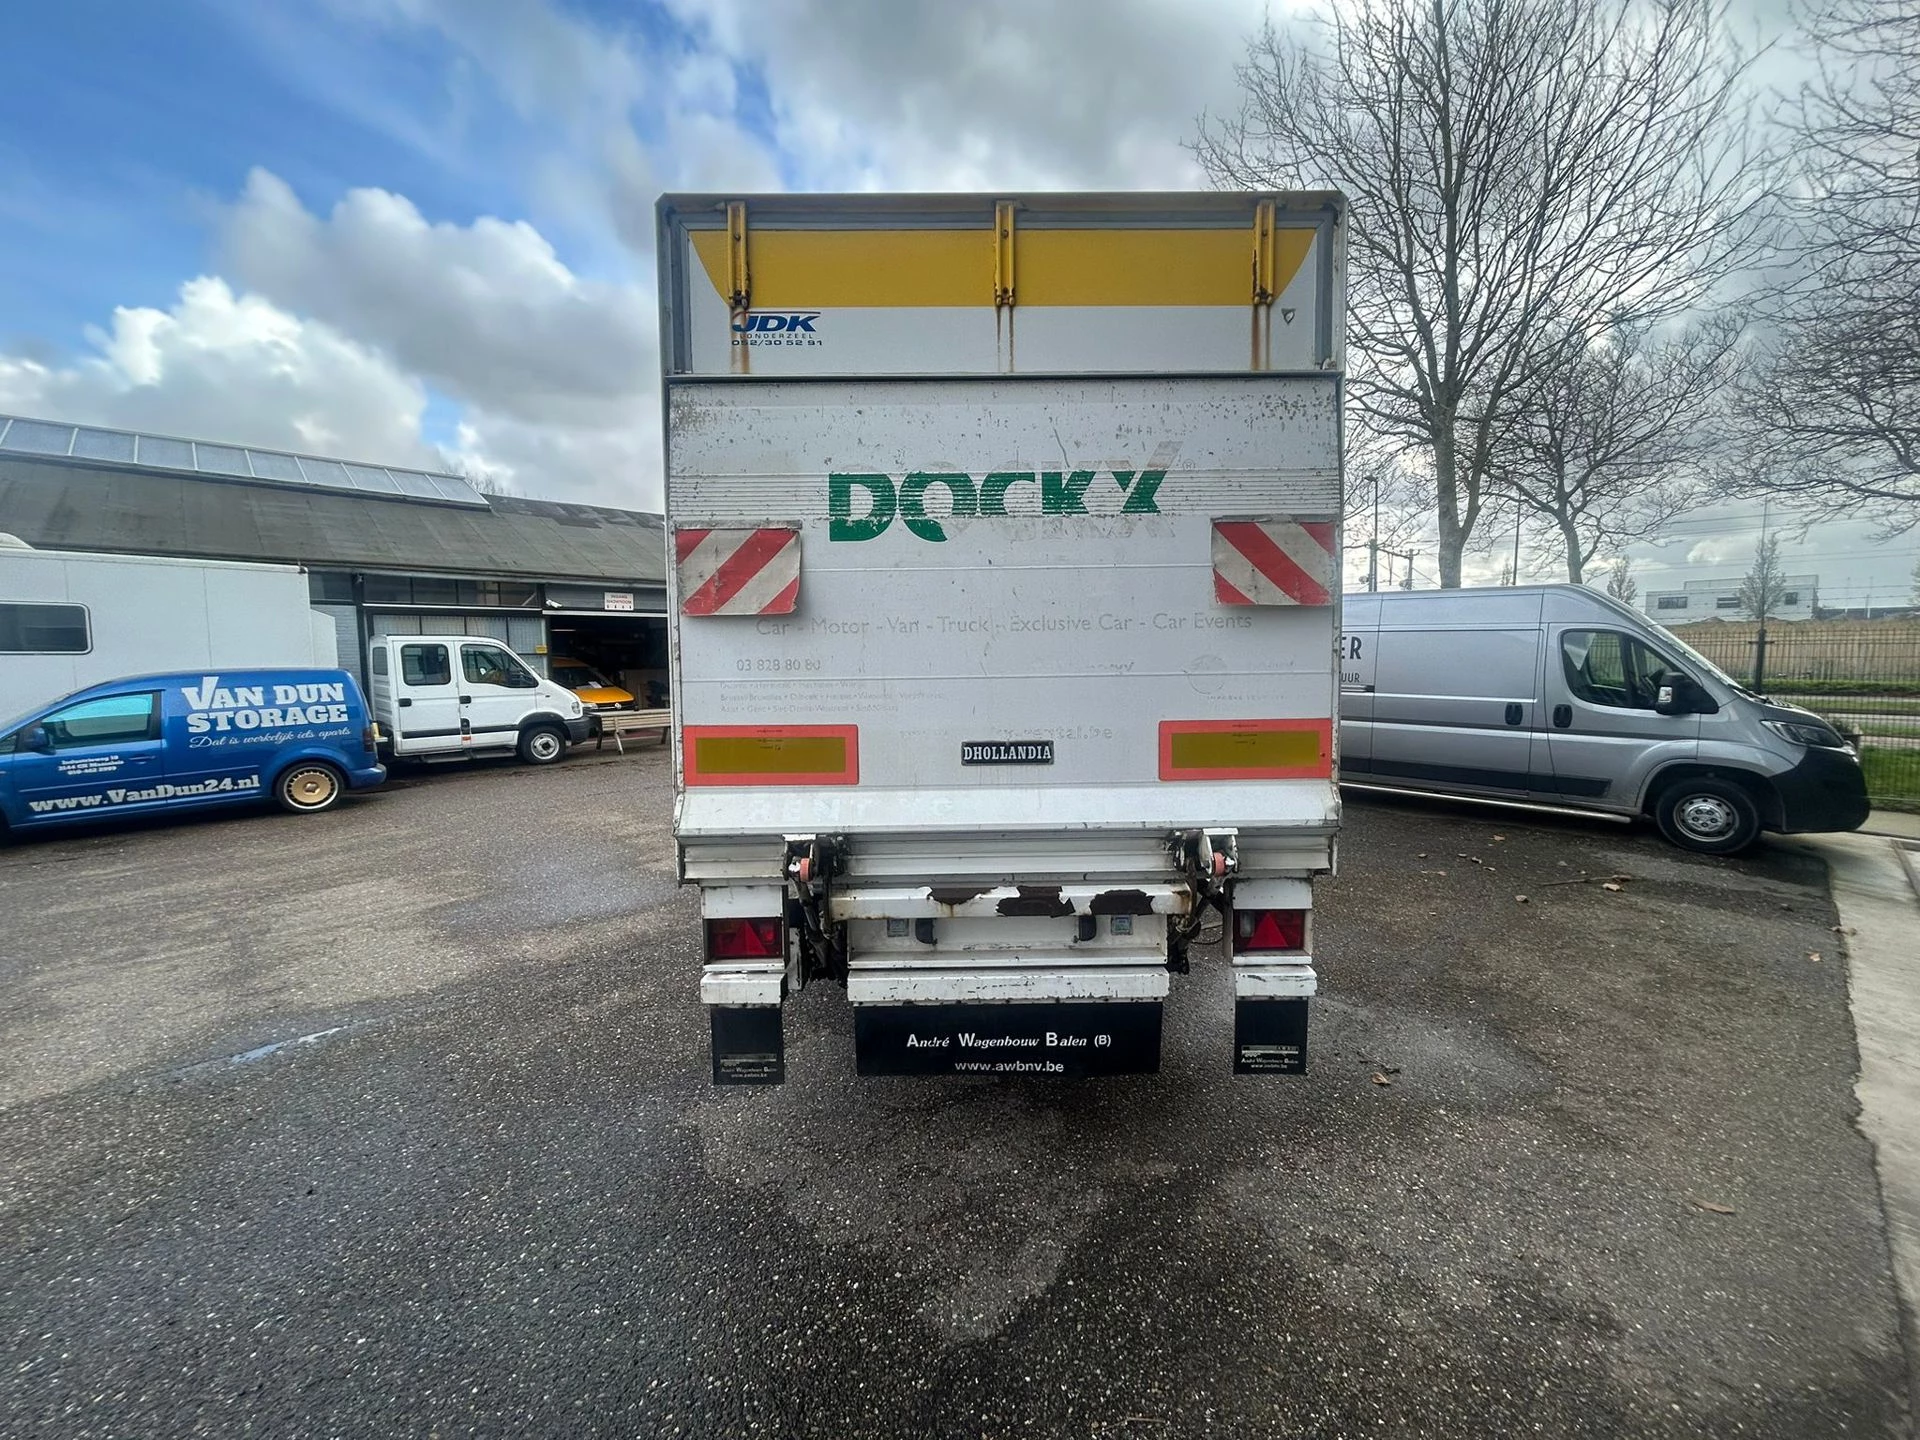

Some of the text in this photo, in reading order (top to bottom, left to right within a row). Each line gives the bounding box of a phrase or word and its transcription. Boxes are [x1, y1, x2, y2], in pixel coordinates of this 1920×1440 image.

[732, 315, 820, 332] JDK
[756, 619, 790, 636] Car
[812, 618, 869, 635] Motor
[887, 617, 919, 634] Van
[937, 616, 988, 633] Truck
[1010, 614, 1091, 632] Exclusive
[1099, 614, 1131, 631] Car
[1153, 613, 1186, 630] Car
[1194, 613, 1252, 630] Events
[736, 659, 751, 671] 03
[757, 659, 780, 671] 828
[785, 659, 801, 671] 80
[181, 677, 345, 710] VAN DUN
[187, 704, 349, 733] STORAGE
[229, 735, 239, 745] is
[243, 731, 294, 745] werkelijk
[963, 746, 1051, 761] DHOLLANDIA
[29, 774, 260, 812] www.VanDun24.nl
[906, 1032, 1112, 1049] André Wagenbouw Balen (B)
[954, 1060, 1064, 1073] www.awbnv.be
